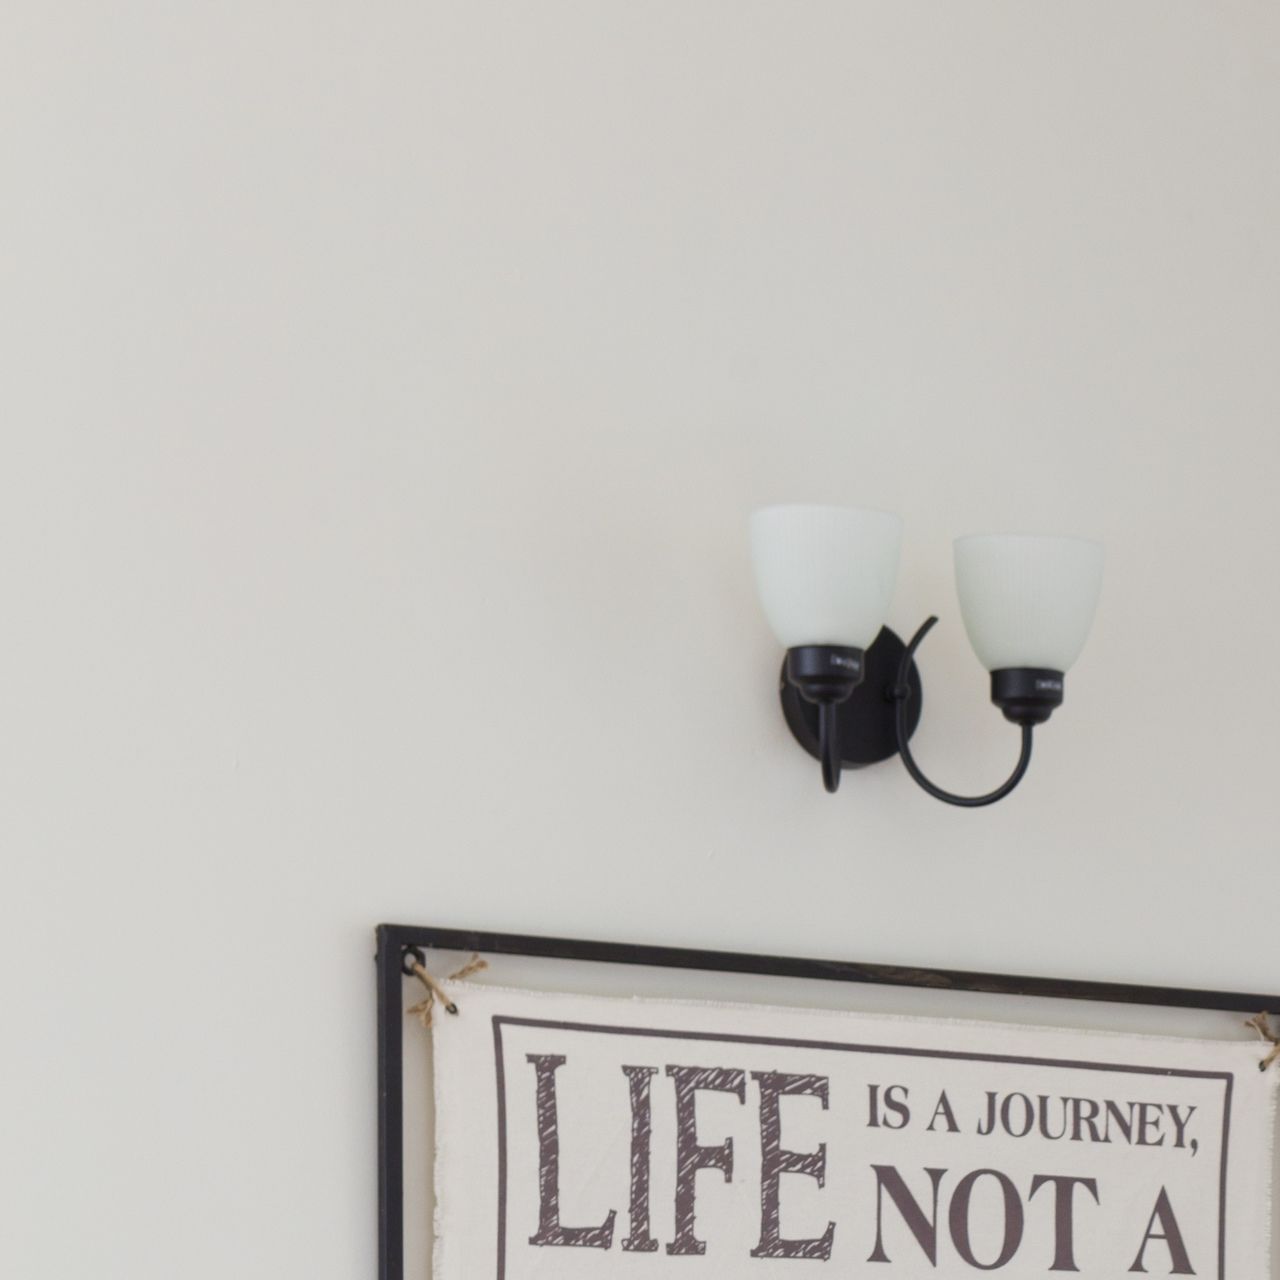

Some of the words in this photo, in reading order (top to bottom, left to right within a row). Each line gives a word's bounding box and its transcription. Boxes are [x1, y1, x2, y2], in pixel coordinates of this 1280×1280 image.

[526, 1053, 836, 1261] LIFE
[867, 1084, 910, 1130] IS
[927, 1089, 961, 1133] A
[977, 1091, 1199, 1157] JOURNEY,
[867, 1165, 1099, 1272] NOT
[1128, 1186, 1197, 1276] A
